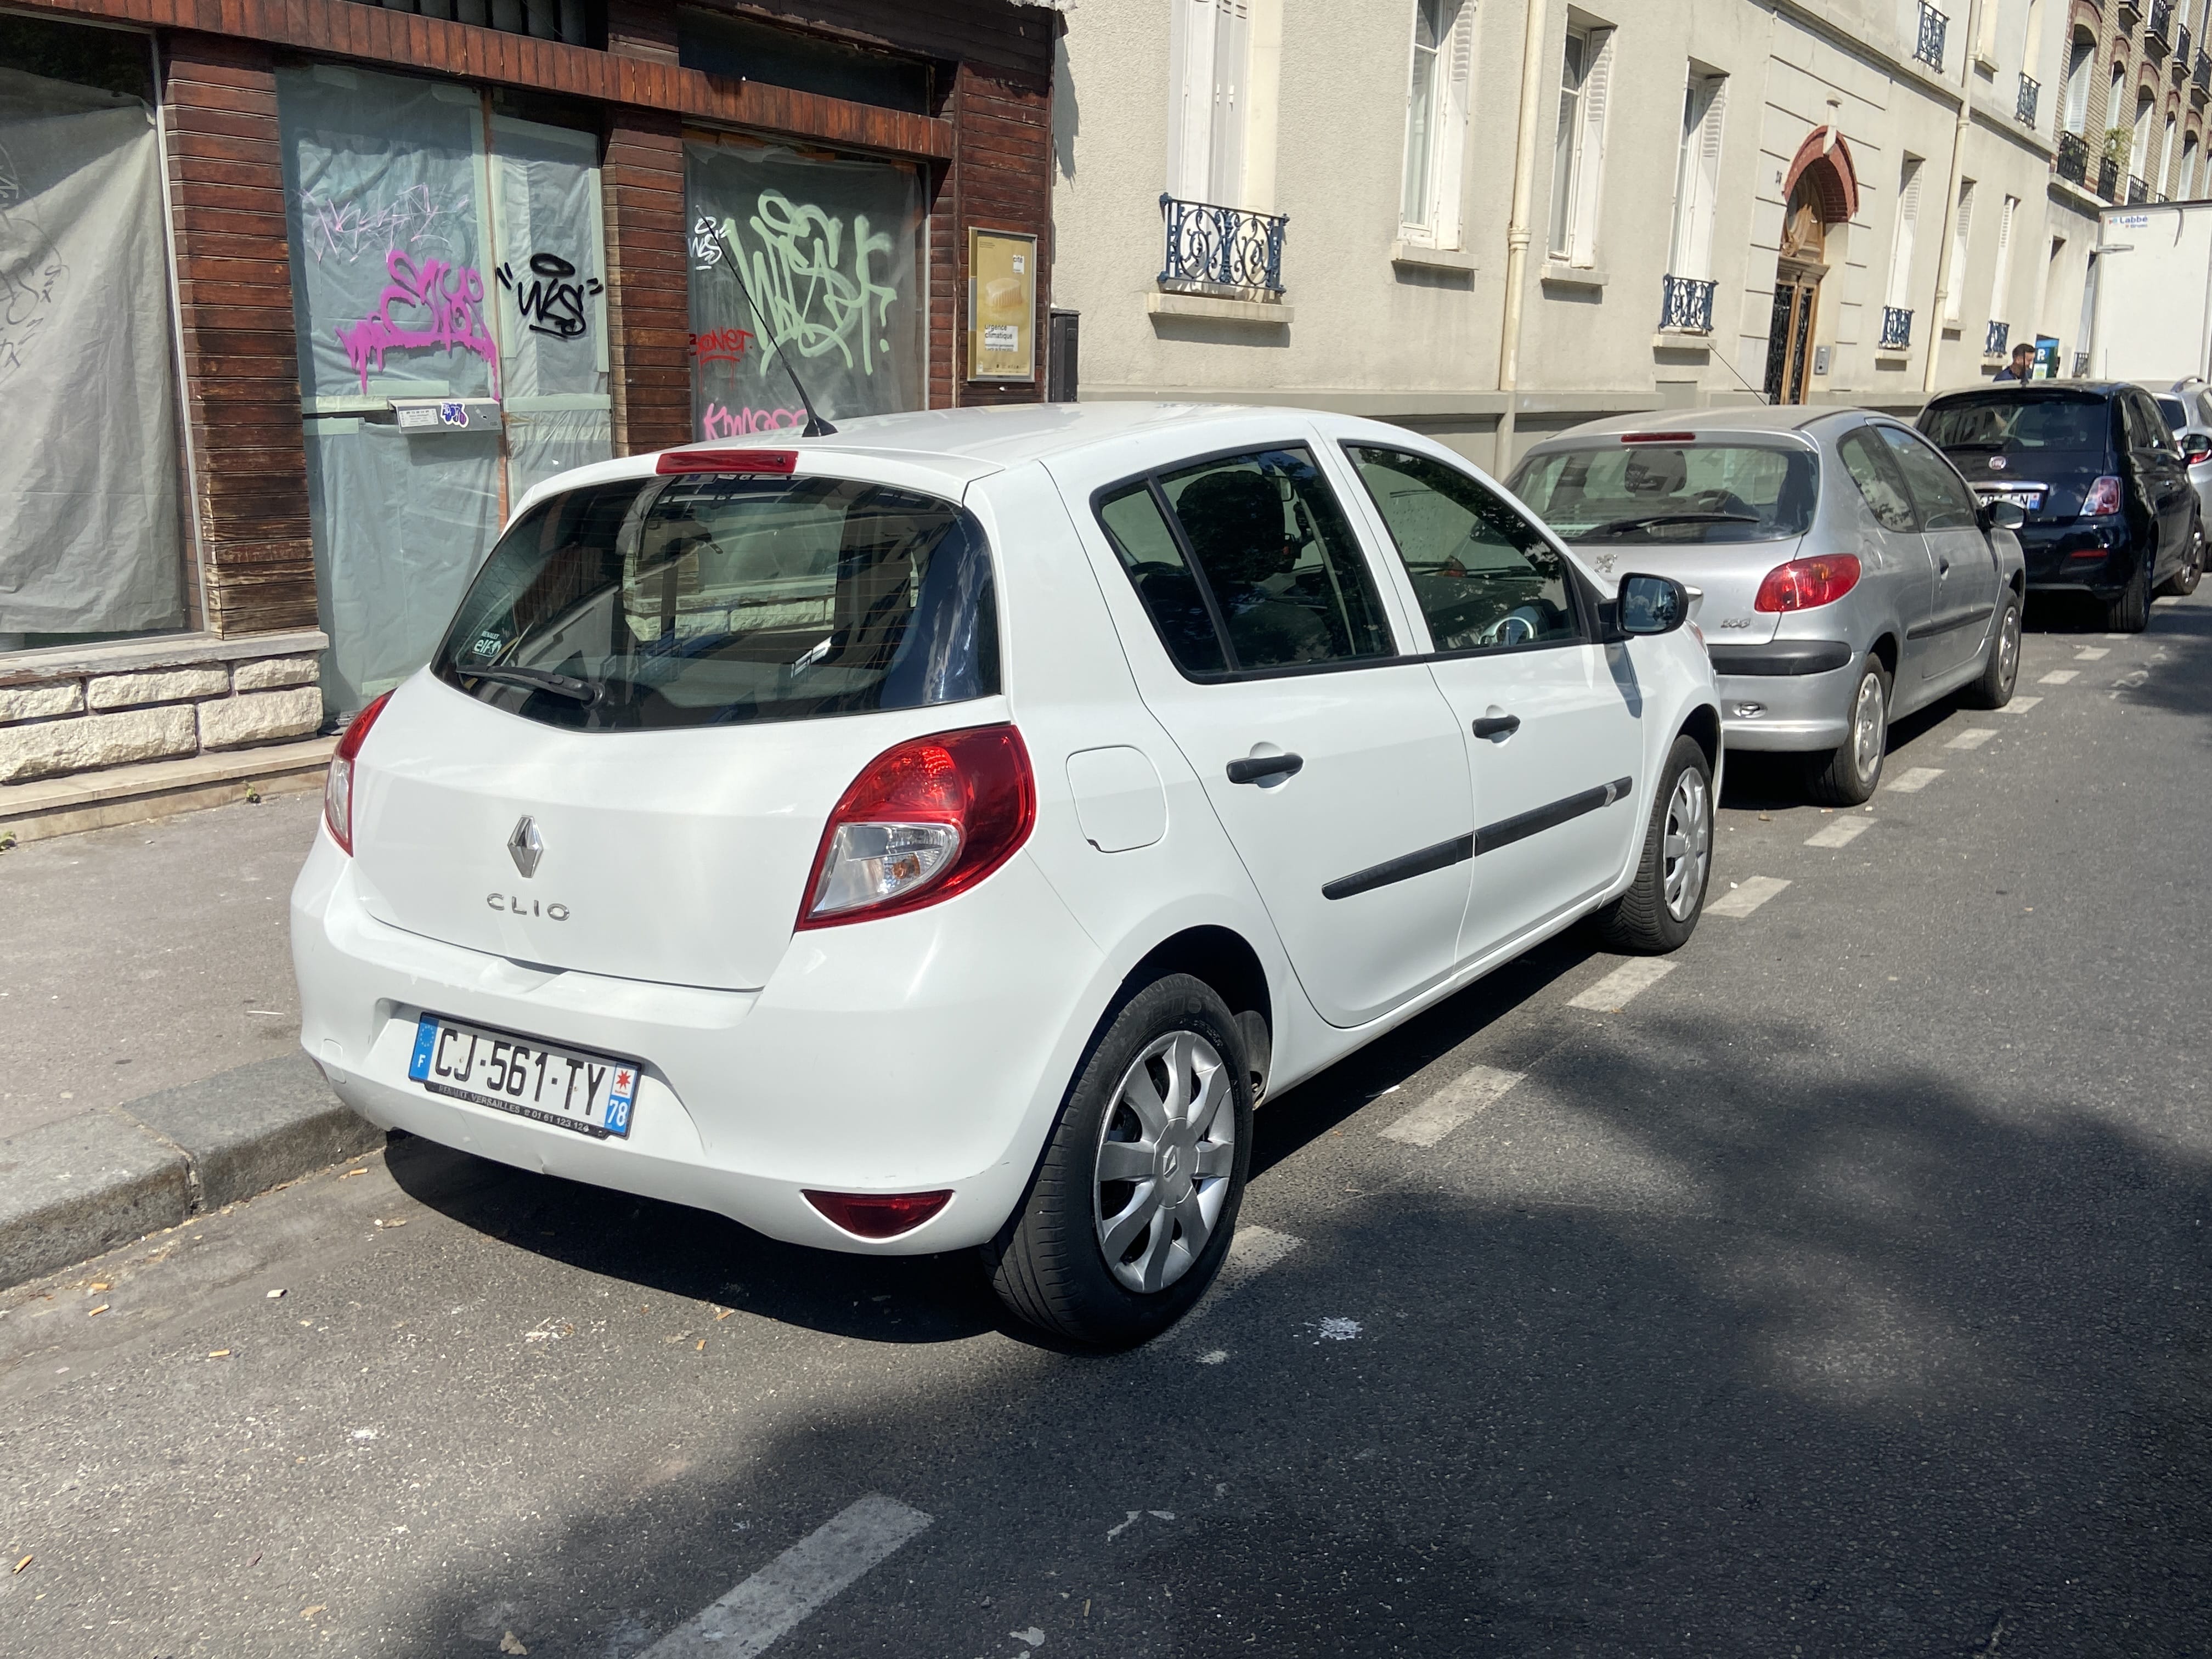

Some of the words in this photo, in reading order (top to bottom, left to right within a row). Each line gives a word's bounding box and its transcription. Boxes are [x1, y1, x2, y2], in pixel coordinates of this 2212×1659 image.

[985, 331, 1013, 340] climatique
[474, 639, 494, 653] elf
[487, 893, 570, 921] CLIO
[417, 1054, 426, 1068] F
[435, 1028, 606, 1115] CJ-561-TY
[471, 1093, 520, 1114] VERSAILLES
[532, 1110, 541, 1119] 01
[544, 1114, 554, 1122] 61
[556, 1118, 571, 1127] 123
[607, 1099, 628, 1127] 78
